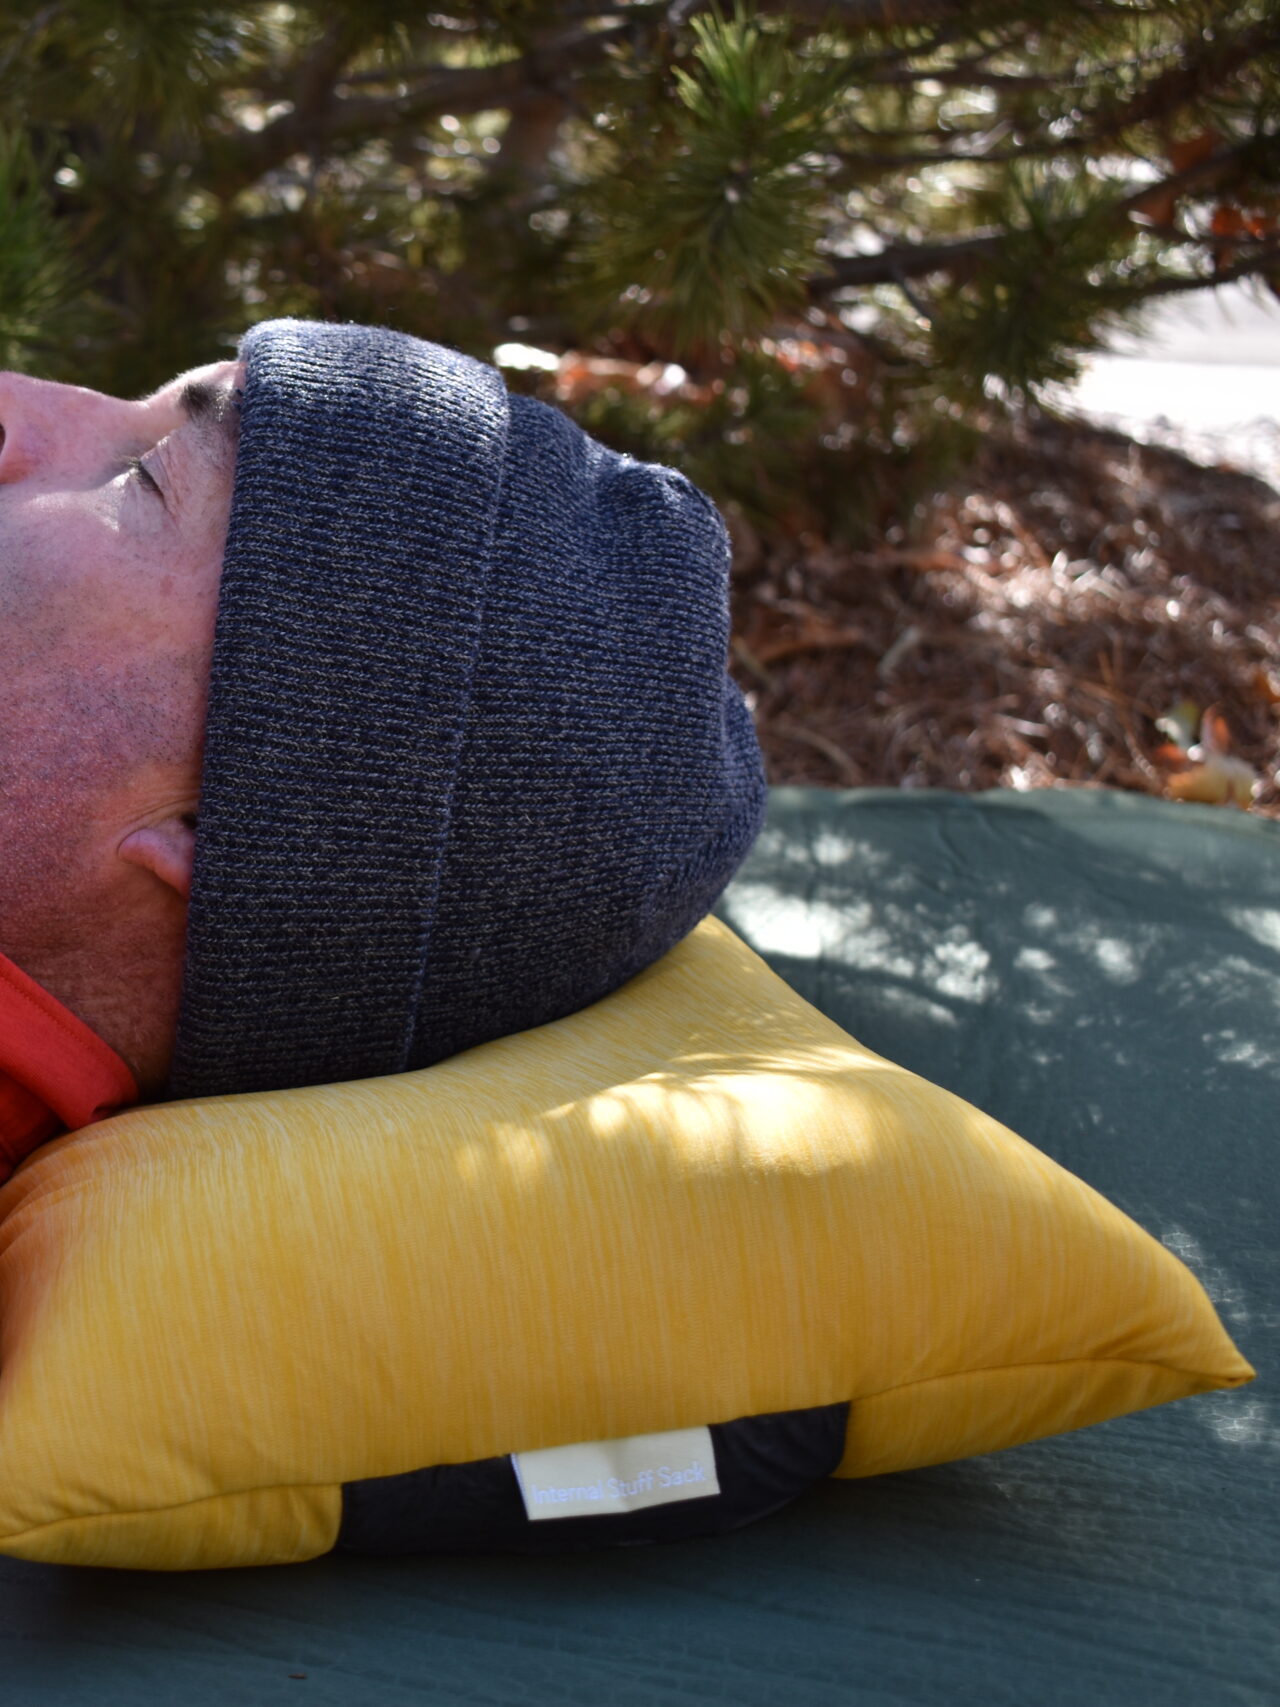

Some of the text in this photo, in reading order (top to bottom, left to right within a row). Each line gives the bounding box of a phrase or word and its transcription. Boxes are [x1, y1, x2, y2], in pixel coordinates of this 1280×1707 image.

[531, 1461, 706, 1504] Internal Stuff Sack
